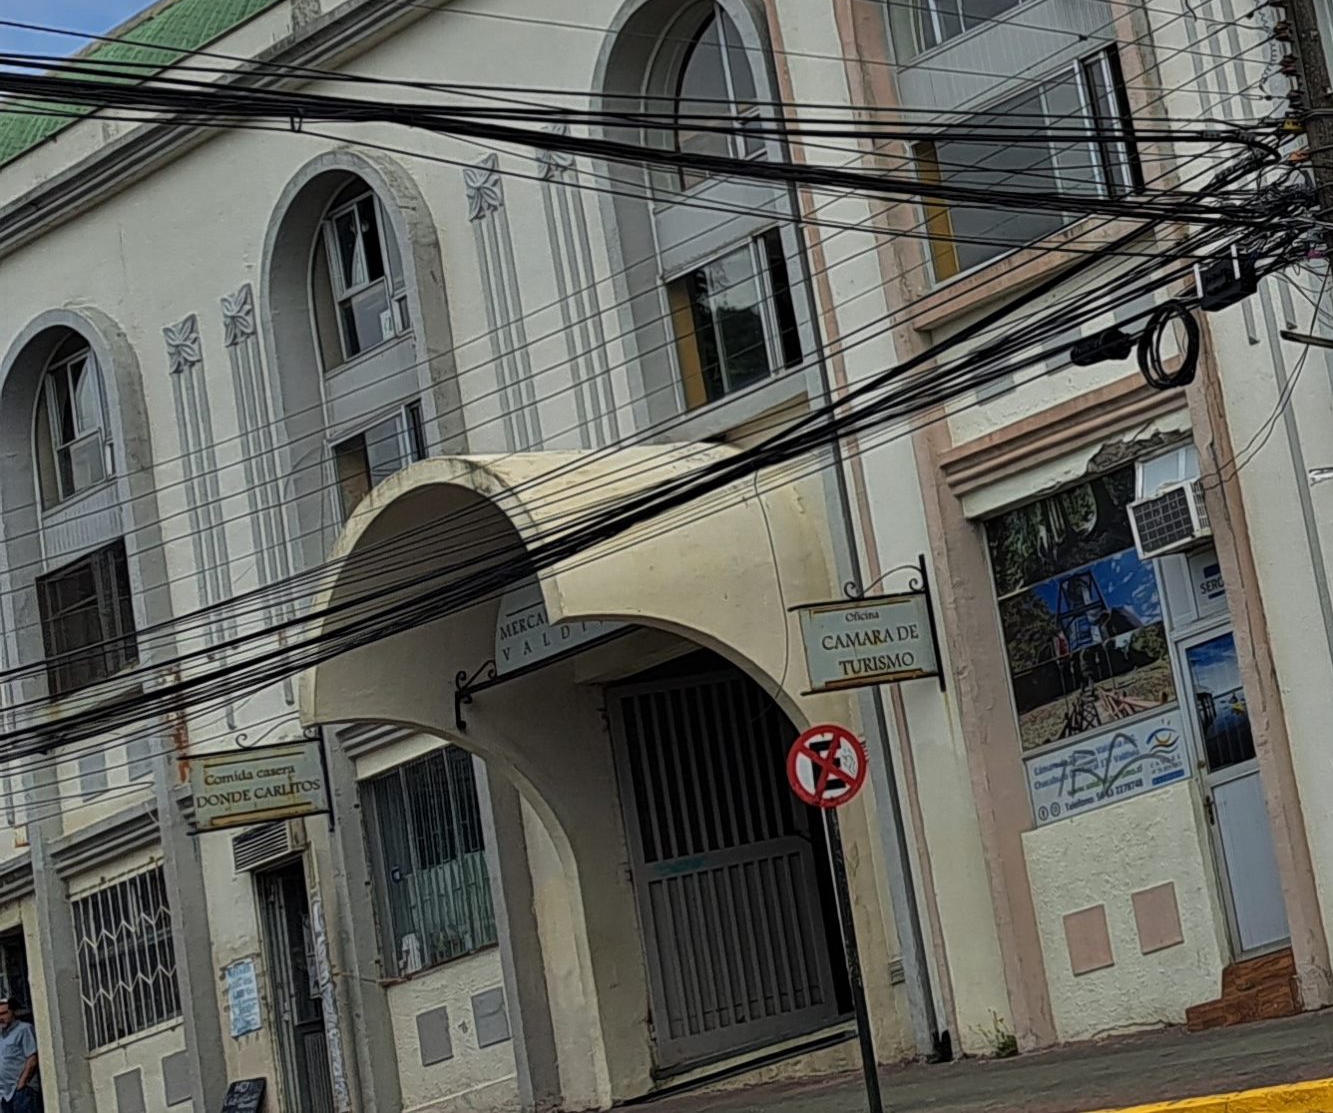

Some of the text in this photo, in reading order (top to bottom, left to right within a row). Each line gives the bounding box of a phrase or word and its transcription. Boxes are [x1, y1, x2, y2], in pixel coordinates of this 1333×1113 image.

[500, 611, 547, 640] MERCA
[845, 610, 879, 622] Oficina
[822, 624, 919, 650] CAMARA DE
[838, 652, 914, 675] TURISMO
[204, 765, 295, 786] Comida casera
[196, 779, 320, 808] DONDE CARLITOS
